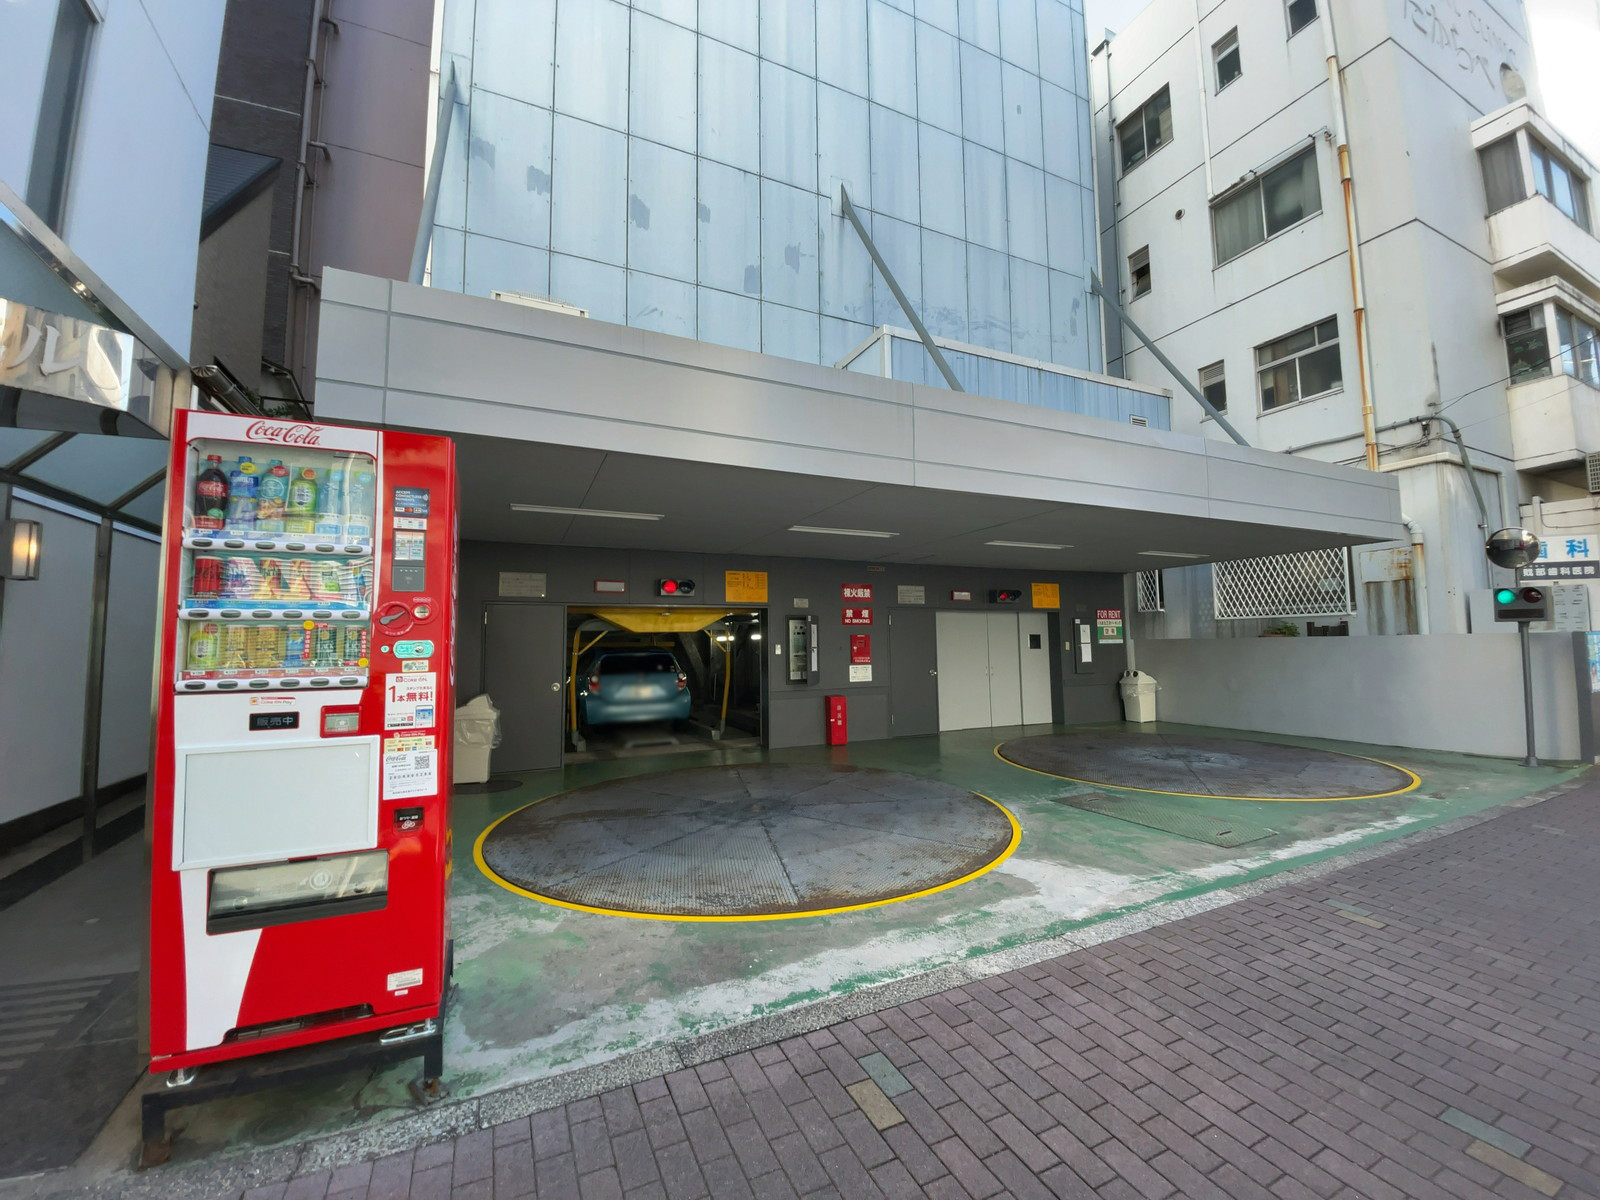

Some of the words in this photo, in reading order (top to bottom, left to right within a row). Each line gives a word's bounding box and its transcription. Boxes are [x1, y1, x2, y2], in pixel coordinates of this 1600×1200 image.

[246, 420, 324, 446] Coca-Cola
[1097, 610, 1108, 619] FOR
[1108, 610, 1121, 619] RENT
